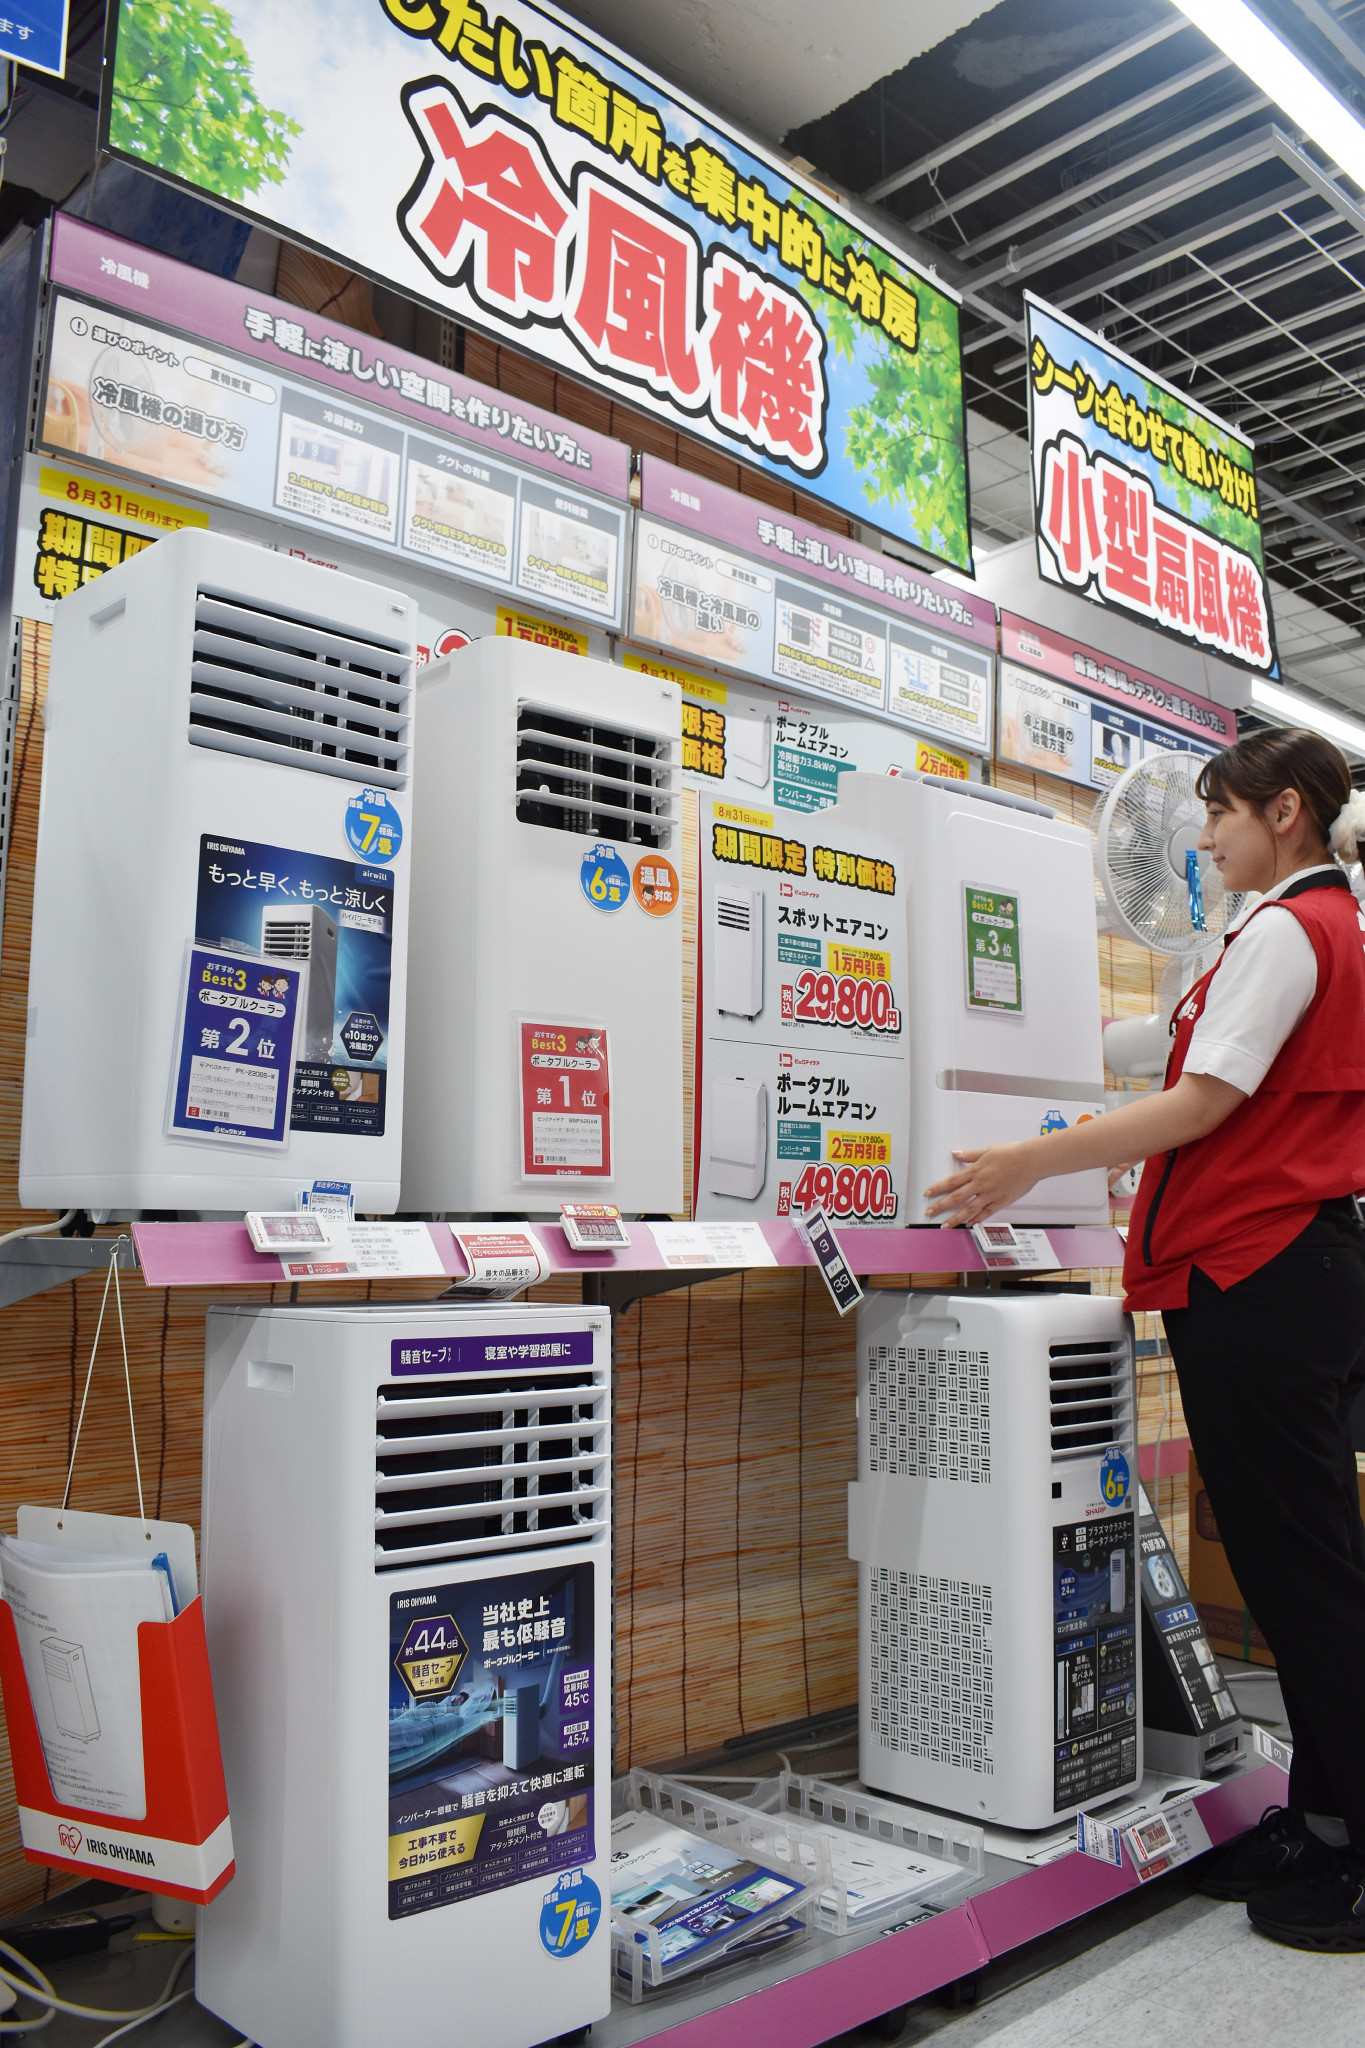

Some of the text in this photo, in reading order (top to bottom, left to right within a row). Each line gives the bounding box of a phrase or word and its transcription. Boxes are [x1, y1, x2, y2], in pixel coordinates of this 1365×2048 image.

[101, 256, 150, 290] 冷風機
[419, 100, 817, 459] 冷風機
[92, 326, 252, 395] 選びのポイント 夏物家電
[246, 307, 592, 468] 手軽に涼しい空間を作りたい方に
[94, 379, 247, 450] 冷風機の選び方
[1031, 339, 1259, 518] シーンに合わせて使い分け!
[437, 454, 490, 482] ダクトの有無
[66, 480, 184, 530] 8月31日(月)まで
[660, 539, 713, 568] 選びのポイント
[1049, 450, 1266, 659] 小型扇風機
[757, 518, 974, 627] 手軽に涼しい空間を作りたい方に
[657, 577, 761, 631] 冷風機と冷風扇の
[694, 609, 724, 634] 違い
[1073, 652, 1227, 734] 書斎や職場のデスクに置きたい方に
[776, 716, 830, 740] ポータブル
[1023, 713, 1074, 742] 卓上扇風機の
[776, 730, 849, 759] ルームエアコン
[1032, 731, 1066, 754] 給電方法
[777, 750, 837, 773] 冷房能力3.8kWの
[777, 760, 800, 774] 高出力
[364, 790, 387, 807] 冷風
[718, 806, 769, 827] 8月31日(月)まで
[359, 812, 381, 852] 7
[206, 841, 246, 856] IRIS OHYAMA
[595, 844, 616, 860] 冷風
[713, 826, 896, 896] 期間限定 特別価格
[362, 870, 388, 881] airwill
[590, 866, 608, 901] 6
[640, 866, 671, 888] 温風
[208, 863, 387, 914] もっと早く、もっと涼しく
[654, 889, 673, 903] 対応
[972, 898, 994, 912] Best3
[341, 912, 383, 926] ハイパワーモデル
[777, 905, 889, 941] スポットエアコン
[975, 914, 1011, 927] スポットクーラー
[975, 929, 1013, 957] 第3位
[206, 962, 235, 975] おすすめ
[832, 949, 887, 978] 1万円引き
[202, 969, 247, 992] Best3
[200, 990, 284, 1015] ポータブルクーラー
[781, 988, 793, 1015] 税込
[796, 972, 898, 1028] 29,800円
[200, 1017, 276, 1060] 第2位
[531, 1034, 567, 1053] Best3
[534, 1031, 556, 1039] おすすめ
[532, 1055, 599, 1069] ポータブルクーラー
[536, 1075, 597, 1108] 第1位
[776, 1072, 850, 1097] ポータブル
[776, 1096, 877, 1121] ルームエアコン
[831, 1137, 887, 1160] 2万円引き
[778, 1185, 791, 1212] 税込
[811, 1223, 823, 1237] フロア
[819, 1238, 830, 1253] 3
[485, 1268, 530, 1277] 最大の品揃えで
[830, 1262, 838, 1273] タナ
[833, 1273, 850, 1293] 33
[401, 1346, 447, 1365] 騒音セーブ
[484, 1342, 571, 1361] 寝室や学習部屋に
[1105, 1469, 1117, 1500] 6
[1085, 1506, 1107, 1516] SHARP
[1088, 1520, 1132, 1537] プラズマクラスター
[1088, 1531, 1133, 1549] ポータブルクーラー
[1141, 1537, 1167, 1553] 内部清浄
[397, 1594, 437, 1610] IRIS OHYAMA
[482, 1595, 550, 1627] 当社史上
[1166, 1611, 1190, 1624] 工事不要
[482, 1617, 566, 1652] 最も低騒音
[411, 1657, 454, 1679] 騒音セーブ
[484, 1650, 540, 1669] ポータブルクーラー
[419, 1675, 445, 1687] モード搭載
[564, 1680, 590, 1694] 猛暑対応
[1071, 1669, 1094, 1683] 窓パネル
[564, 1692, 590, 1708] 45℃
[397, 1764, 585, 1825] インバーター搭載で 騒音を抑えて快適に運転
[498, 1811, 535, 1827] 効率よく冷却する
[408, 1829, 457, 1851] 工事不要で
[490, 1830, 543, 1852] アタッチメント付き
[506, 1825, 527, 1838] 隙間用
[86, 1838, 156, 1867] IRIS OHYAMA
[399, 1843, 466, 1869] 今日から使える
[559, 1869, 583, 1890] 冷風
[555, 1898, 578, 1947] 7
